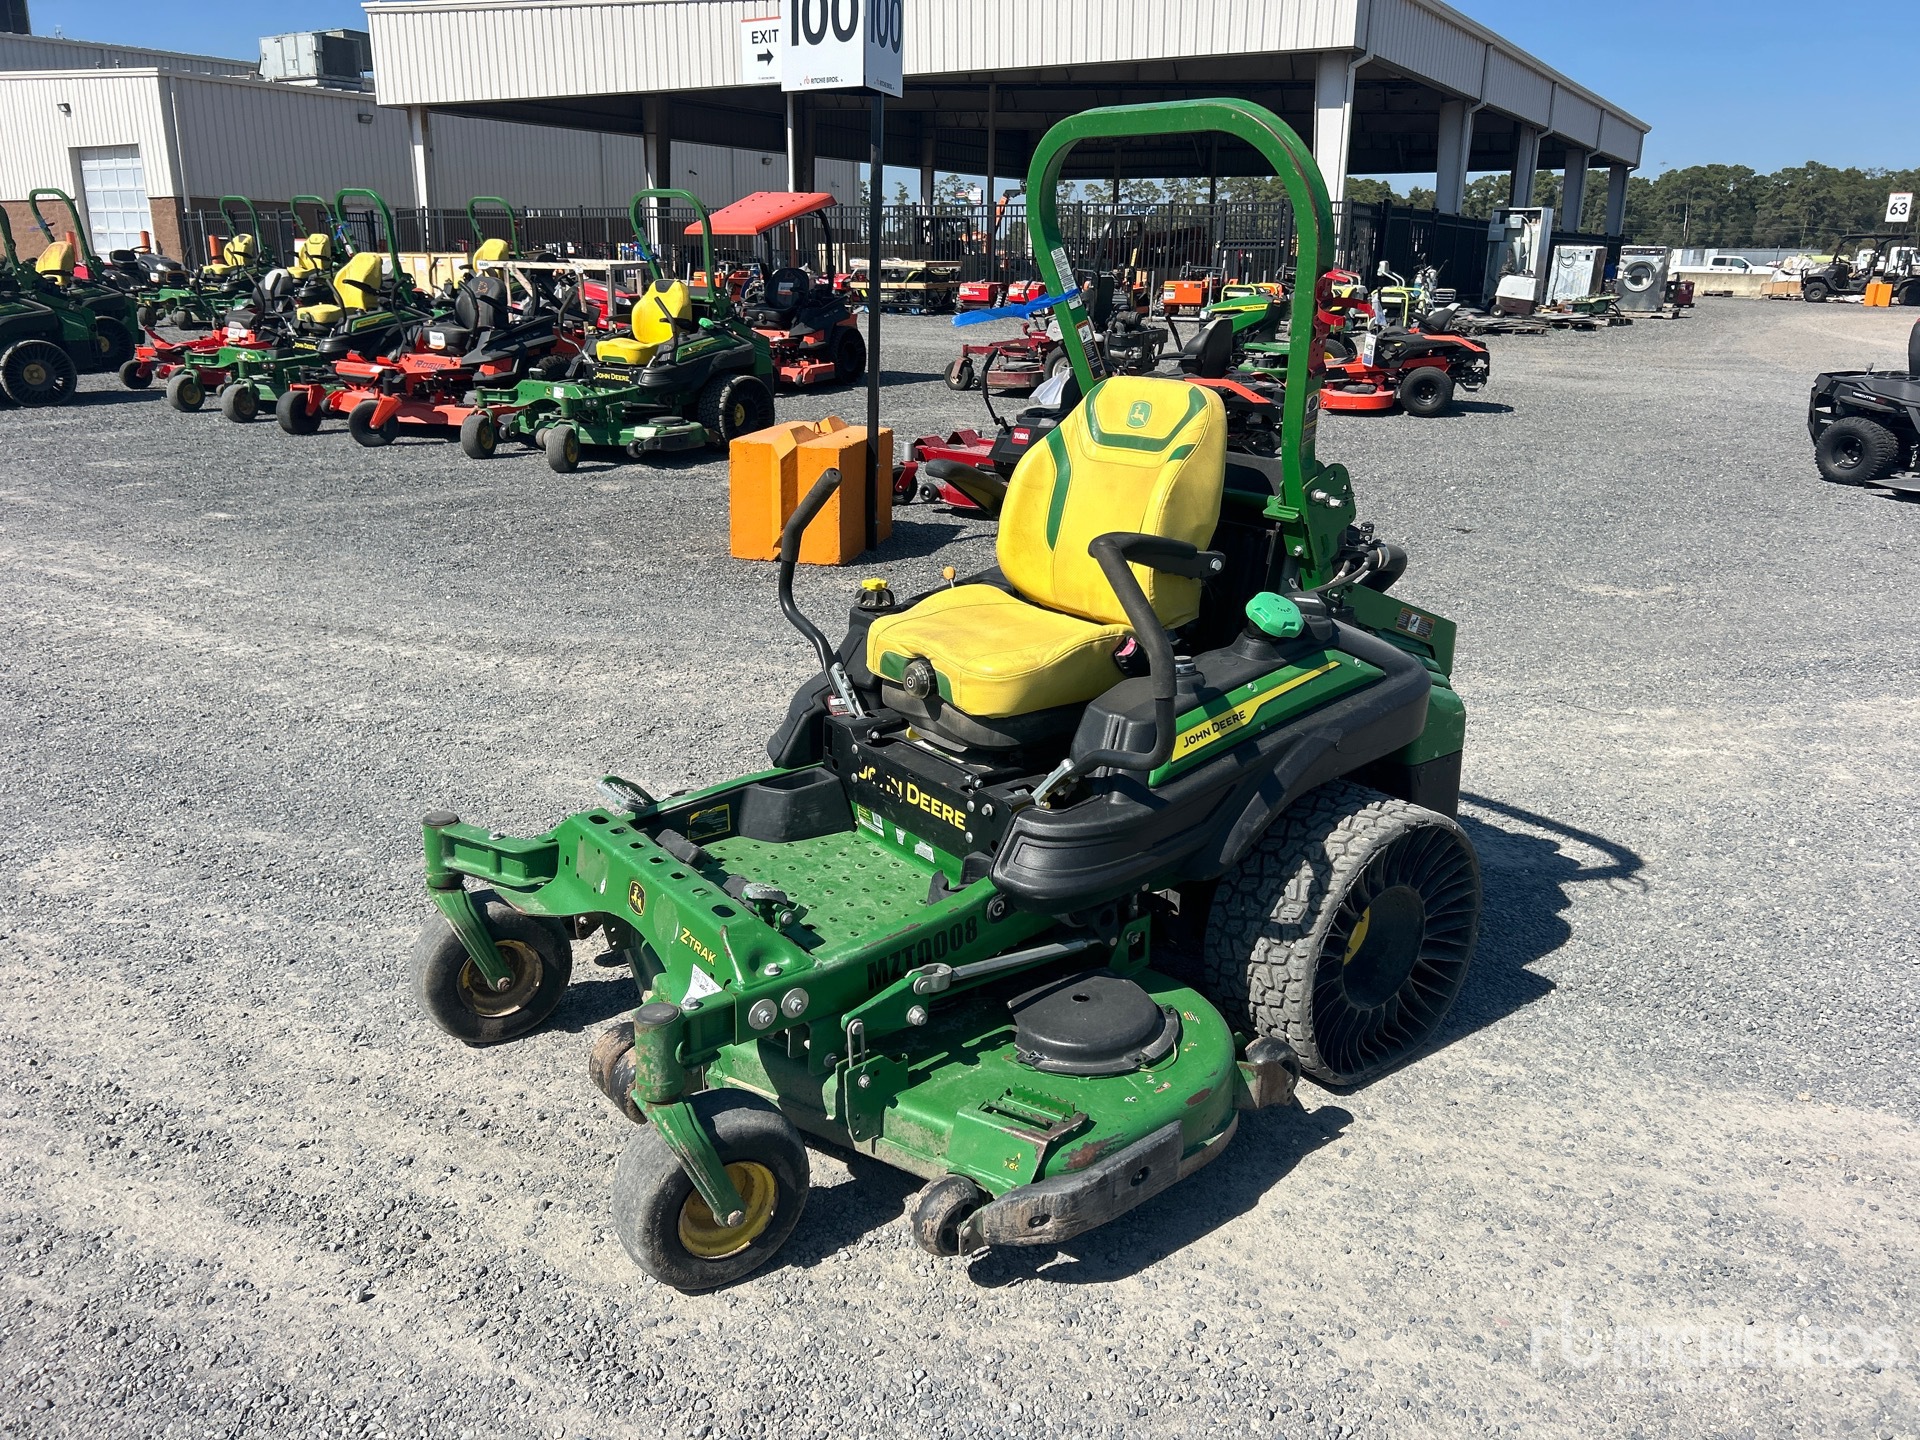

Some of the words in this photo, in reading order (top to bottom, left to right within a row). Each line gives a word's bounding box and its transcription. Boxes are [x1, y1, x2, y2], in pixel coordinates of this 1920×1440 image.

[792, 0, 859, 46] 100
[751, 29, 779, 45] EXIT
[1890, 202, 1908, 215] 63
[414, 360, 446, 371] ROGUE
[595, 371, 610, 380] JOHN
[610, 373, 631, 382] DEERE
[1013, 432, 1029, 440] TORO
[1183, 727, 1211, 748] JOHN
[1211, 710, 1247, 734] DEERE
[906, 781, 967, 831] DEERE
[680, 927, 717, 966] ZTRAK
